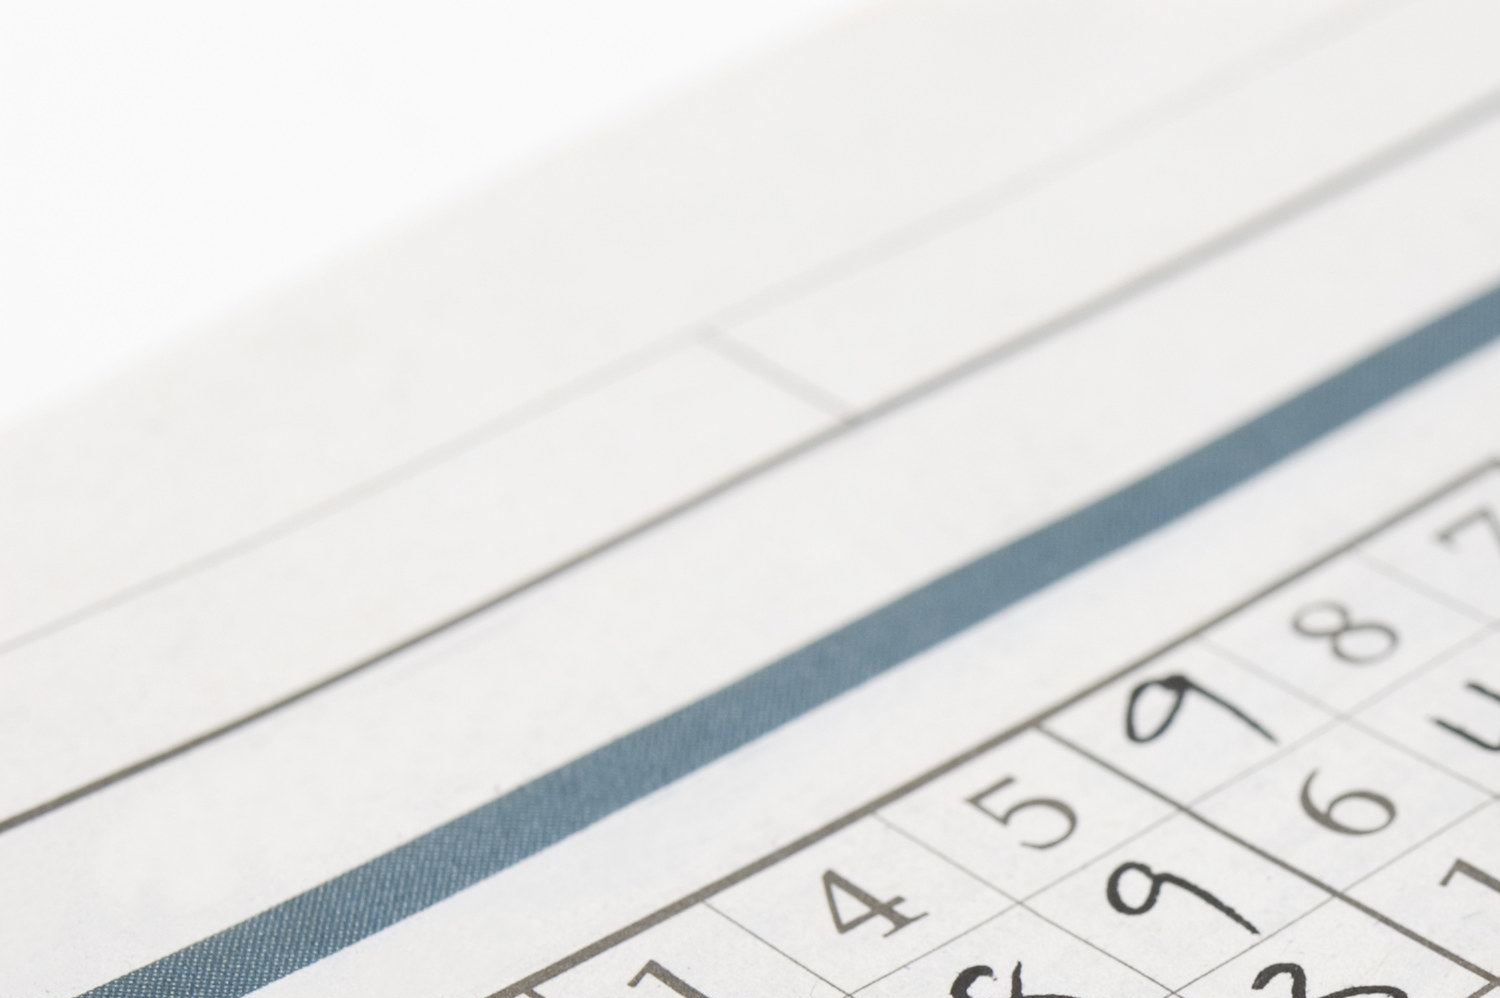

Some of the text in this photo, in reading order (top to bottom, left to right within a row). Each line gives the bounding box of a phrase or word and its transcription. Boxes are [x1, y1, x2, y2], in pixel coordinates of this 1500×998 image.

[1291, 600, 1400, 665] 8
[1125, 674, 1280, 743] 9
[964, 776, 1078, 850] 5
[1300, 768, 1398, 836] 6
[820, 865, 930, 938] 4
[1106, 861, 1261, 936] 9
